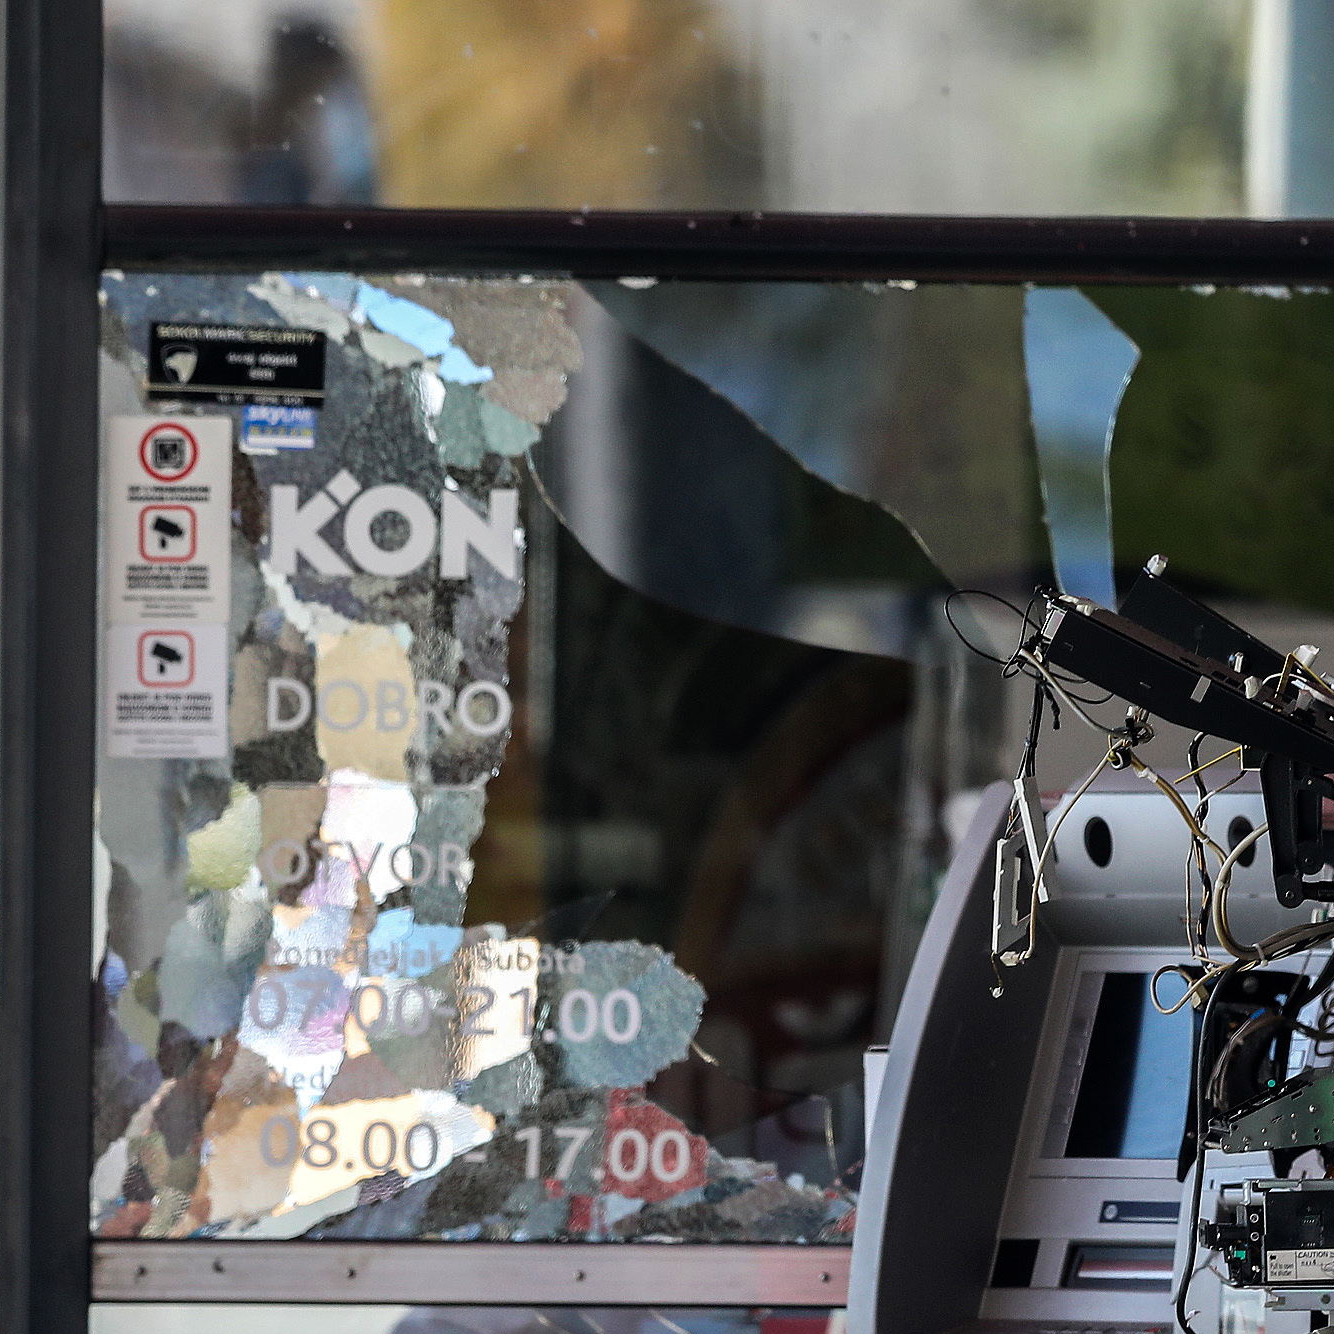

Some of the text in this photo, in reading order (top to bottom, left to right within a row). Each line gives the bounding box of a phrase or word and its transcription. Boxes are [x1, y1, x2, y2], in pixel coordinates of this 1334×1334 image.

[269, 469, 518, 580] KON
[267, 676, 512, 736] DOBRO
[479, 942, 586, 975] Subota
[259, 1116, 441, 1173] 08.00
[514, 1126, 692, 1183] 17.00
[1297, 1251, 1329, 1259] CAUTION
